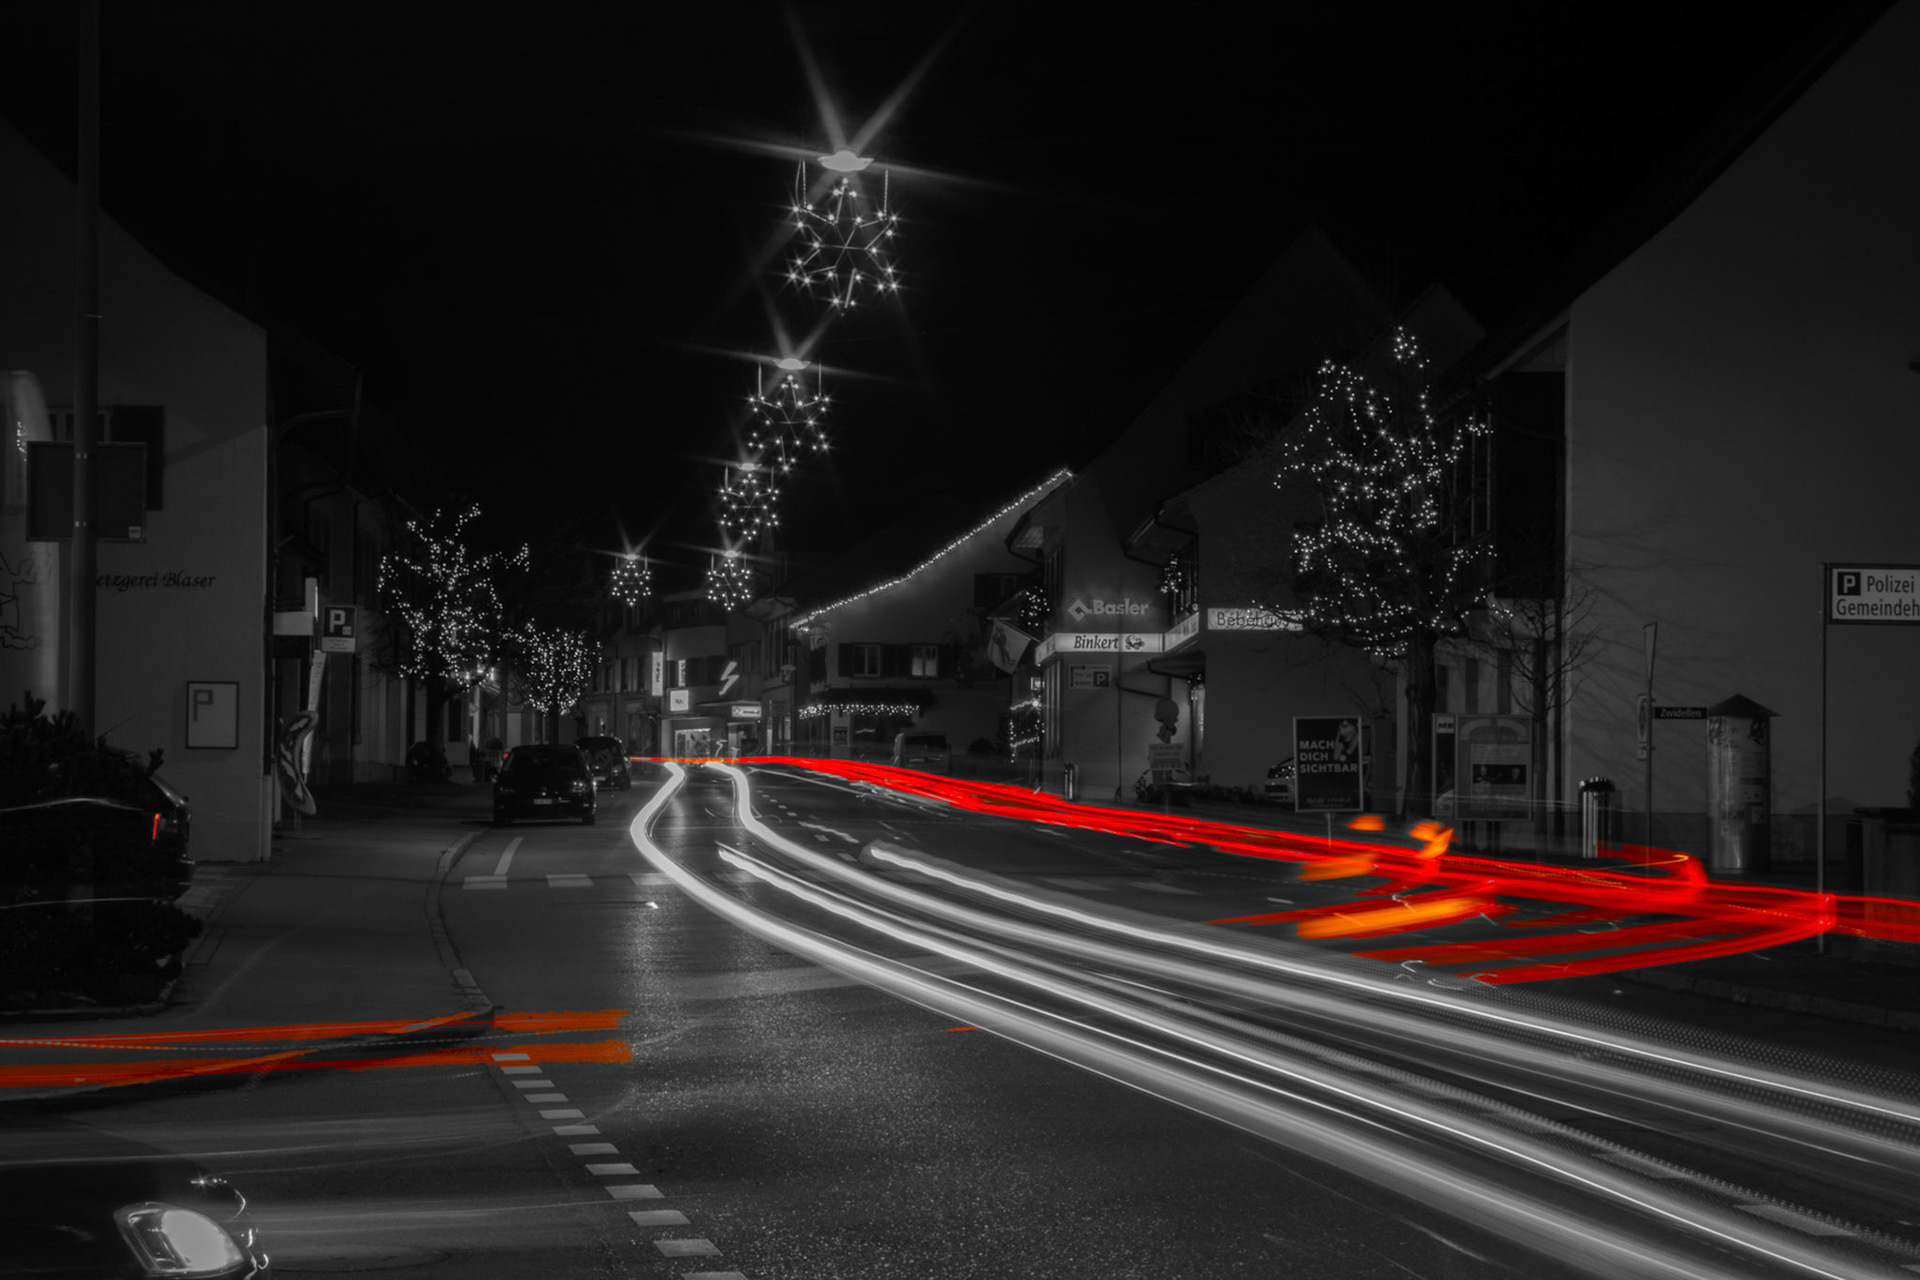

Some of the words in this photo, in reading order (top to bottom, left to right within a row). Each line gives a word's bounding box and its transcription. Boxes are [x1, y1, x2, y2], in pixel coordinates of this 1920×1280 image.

[95, 572, 158, 592] etzgerei
[162, 570, 216, 588] Blaser
[1843, 575, 1856, 594] P
[1867, 575, 1915, 593] Polizei
[1093, 598, 1149, 616] Basler
[329, 609, 346, 634] P
[1074, 635, 1119, 649] Binkert
[1096, 673, 1106, 686] P
[193, 689, 214, 722] P
[1299, 740, 1334, 750] MACH
[1299, 752, 1329, 761] DICH
[1299, 763, 1358, 773] SICHTBAR
